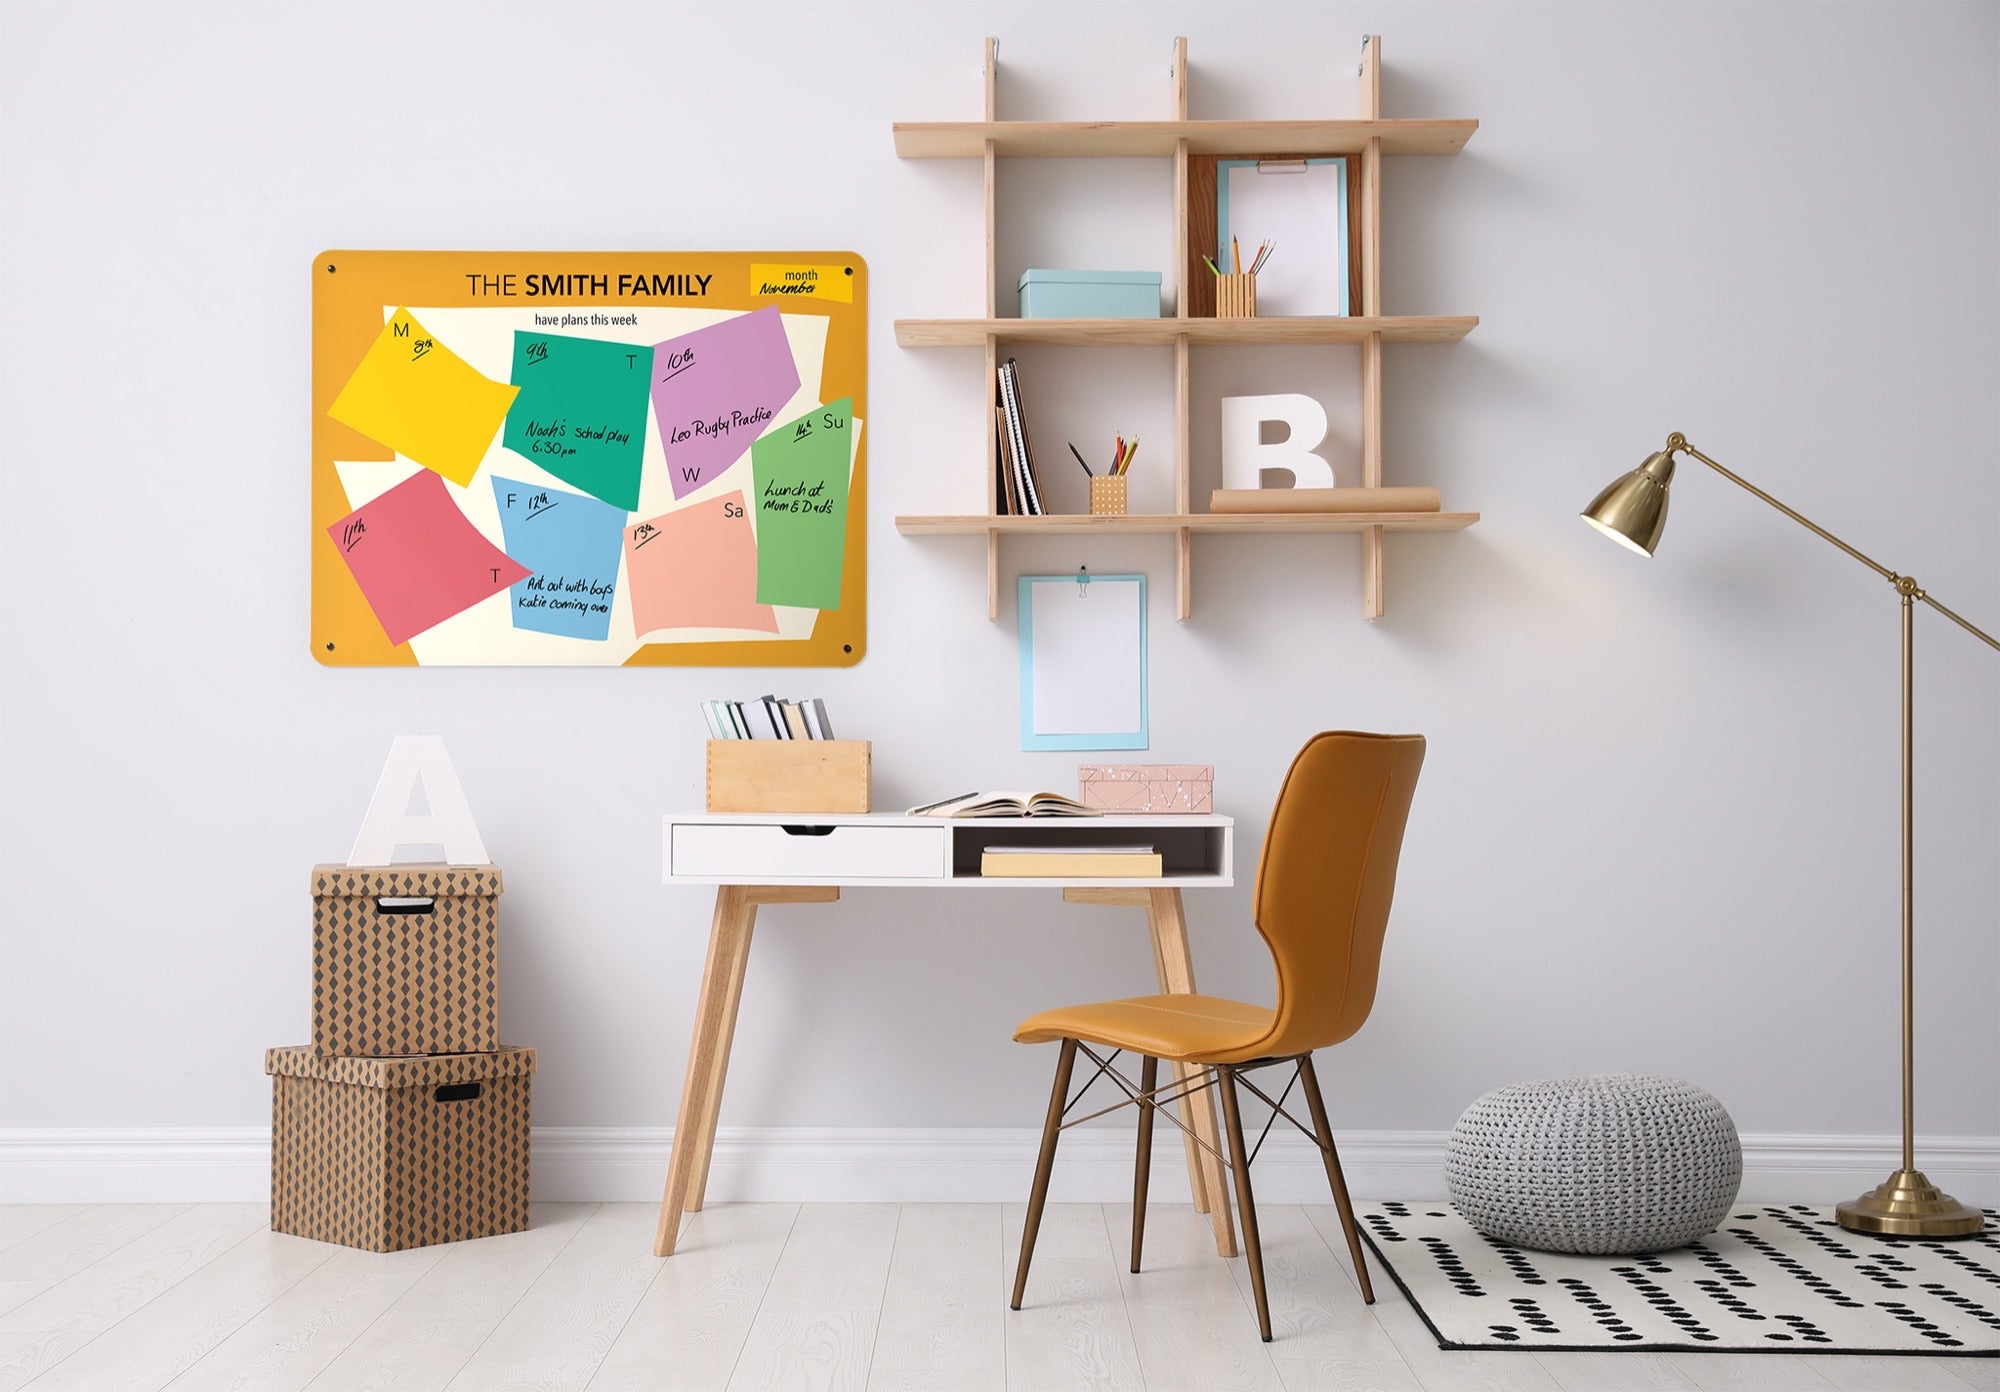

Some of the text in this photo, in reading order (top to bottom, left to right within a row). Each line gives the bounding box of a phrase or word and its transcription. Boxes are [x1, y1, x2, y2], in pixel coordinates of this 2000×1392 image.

[785, 269, 818, 281] month
[466, 274, 713, 296] THE SMITH FAMILY
[759, 281, 816, 295] November
[535, 313, 638, 329] have plans this week
[394, 322, 409, 337] M
[413, 339, 433, 354] 8th
[526, 342, 548, 360] 9th
[625, 354, 637, 369] T
[667, 348, 695, 370] 10th
[670, 406, 772, 444] Leo Rugby Practice
[823, 413, 844, 429] Su
[525, 418, 567, 438] Noah's
[605, 429, 630, 446] play
[1221, 393, 1334, 490] B
[682, 466, 700, 482] W
[764, 478, 825, 497] Lunch at
[507, 493, 517, 509] F
[528, 491, 550, 510] 12th
[724, 502, 744, 518] Sa
[343, 517, 367, 545] 11th
[490, 568, 501, 583] T
[547, 576, 564, 592] out
[565, 578, 589, 593] with
[589, 578, 613, 600] boys
[518, 593, 547, 608] Katie
[346, 734, 492, 867] A
